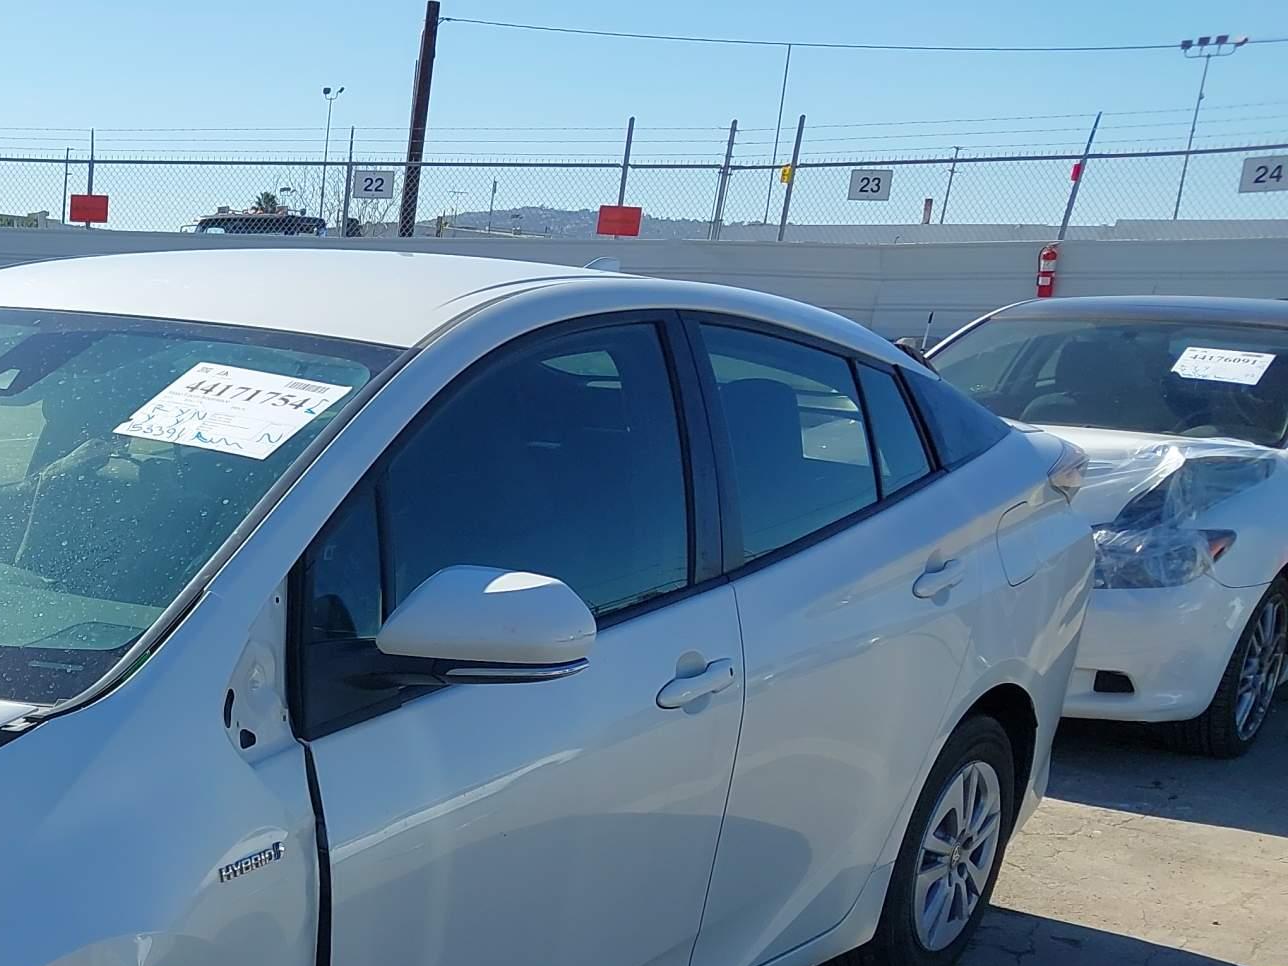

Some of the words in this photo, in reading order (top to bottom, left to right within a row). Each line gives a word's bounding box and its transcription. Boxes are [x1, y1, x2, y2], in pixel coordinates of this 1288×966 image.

[1253, 164, 1283, 184] 24
[363, 177, 385, 192] 22
[859, 177, 881, 193] 23
[1190, 354, 1258, 366] 44176091
[185, 379, 308, 410] 44171754
[218, 848, 274, 883] HYBRID
